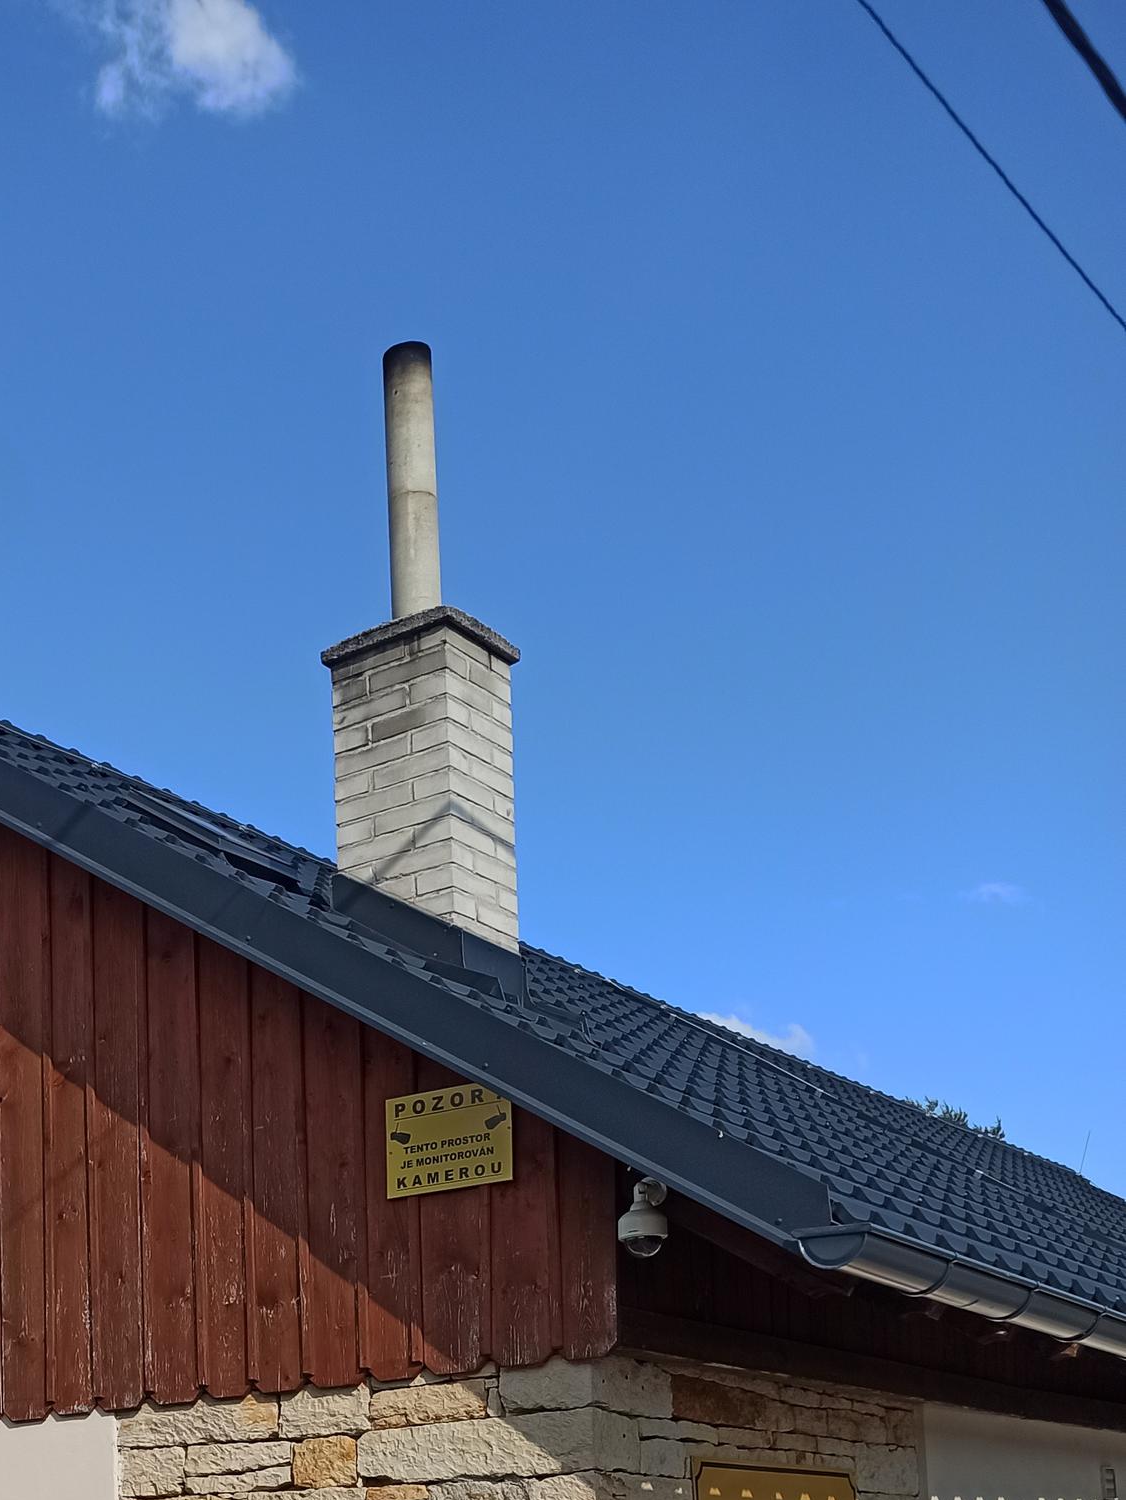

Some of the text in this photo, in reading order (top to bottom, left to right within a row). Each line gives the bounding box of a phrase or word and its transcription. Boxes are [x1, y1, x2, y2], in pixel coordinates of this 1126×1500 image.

[394, 1088, 484, 1118] POZOR
[403, 1132, 491, 1155] TENTO PROSTOR
[400, 1146, 494, 1170] JE MONITOROVÁN
[396, 1161, 502, 1189] KAMEROU
